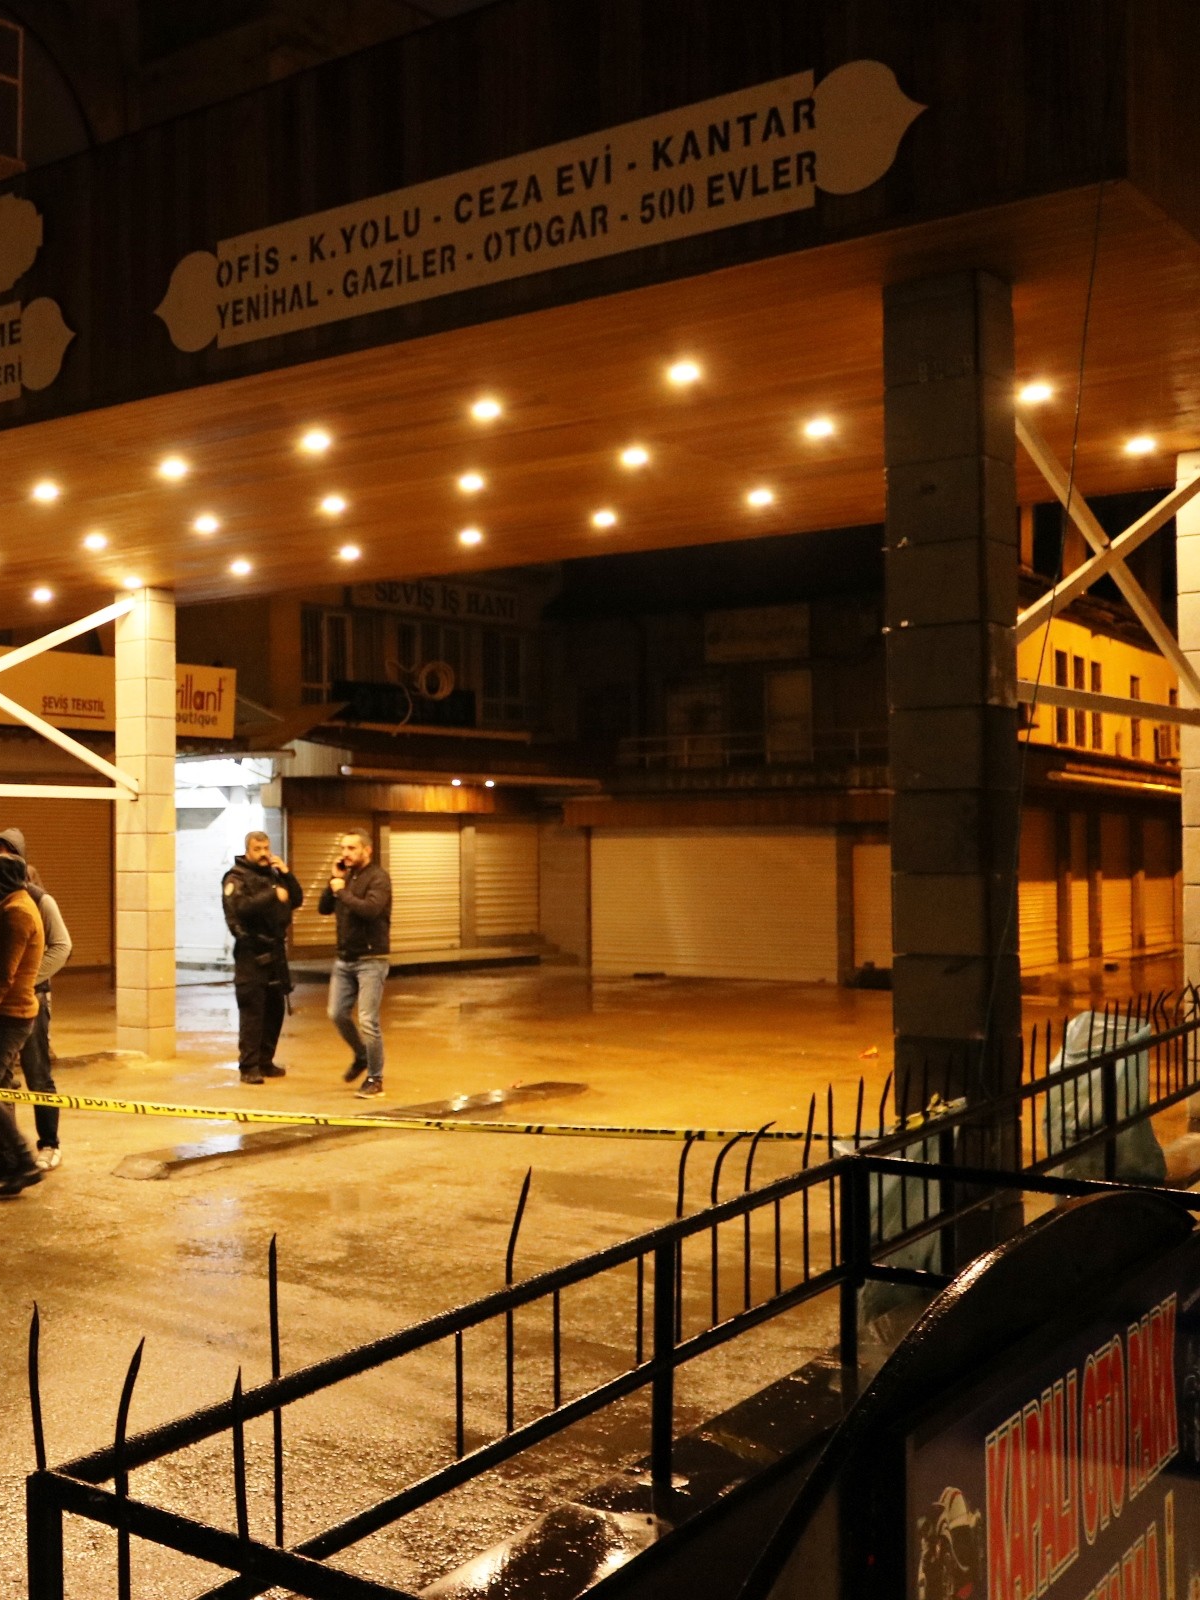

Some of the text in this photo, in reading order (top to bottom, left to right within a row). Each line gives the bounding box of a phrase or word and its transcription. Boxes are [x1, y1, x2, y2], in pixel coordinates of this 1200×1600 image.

[216, 244, 280, 289] OFİS
[308, 206, 421, 263] K.YOLU
[453, 174, 543, 224] CEZA
[556, 143, 612, 198] EVİ
[652, 97, 817, 172] KANTAR
[216, 281, 319, 329] YENİHAL
[342, 244, 456, 298] GAZİLER
[483, 204, 608, 262] OTOGAR
[640, 183, 694, 225] 500
[707, 150, 817, 208] EVLER
[985, 1291, 1180, 1600] KAPALI OTO PARK
